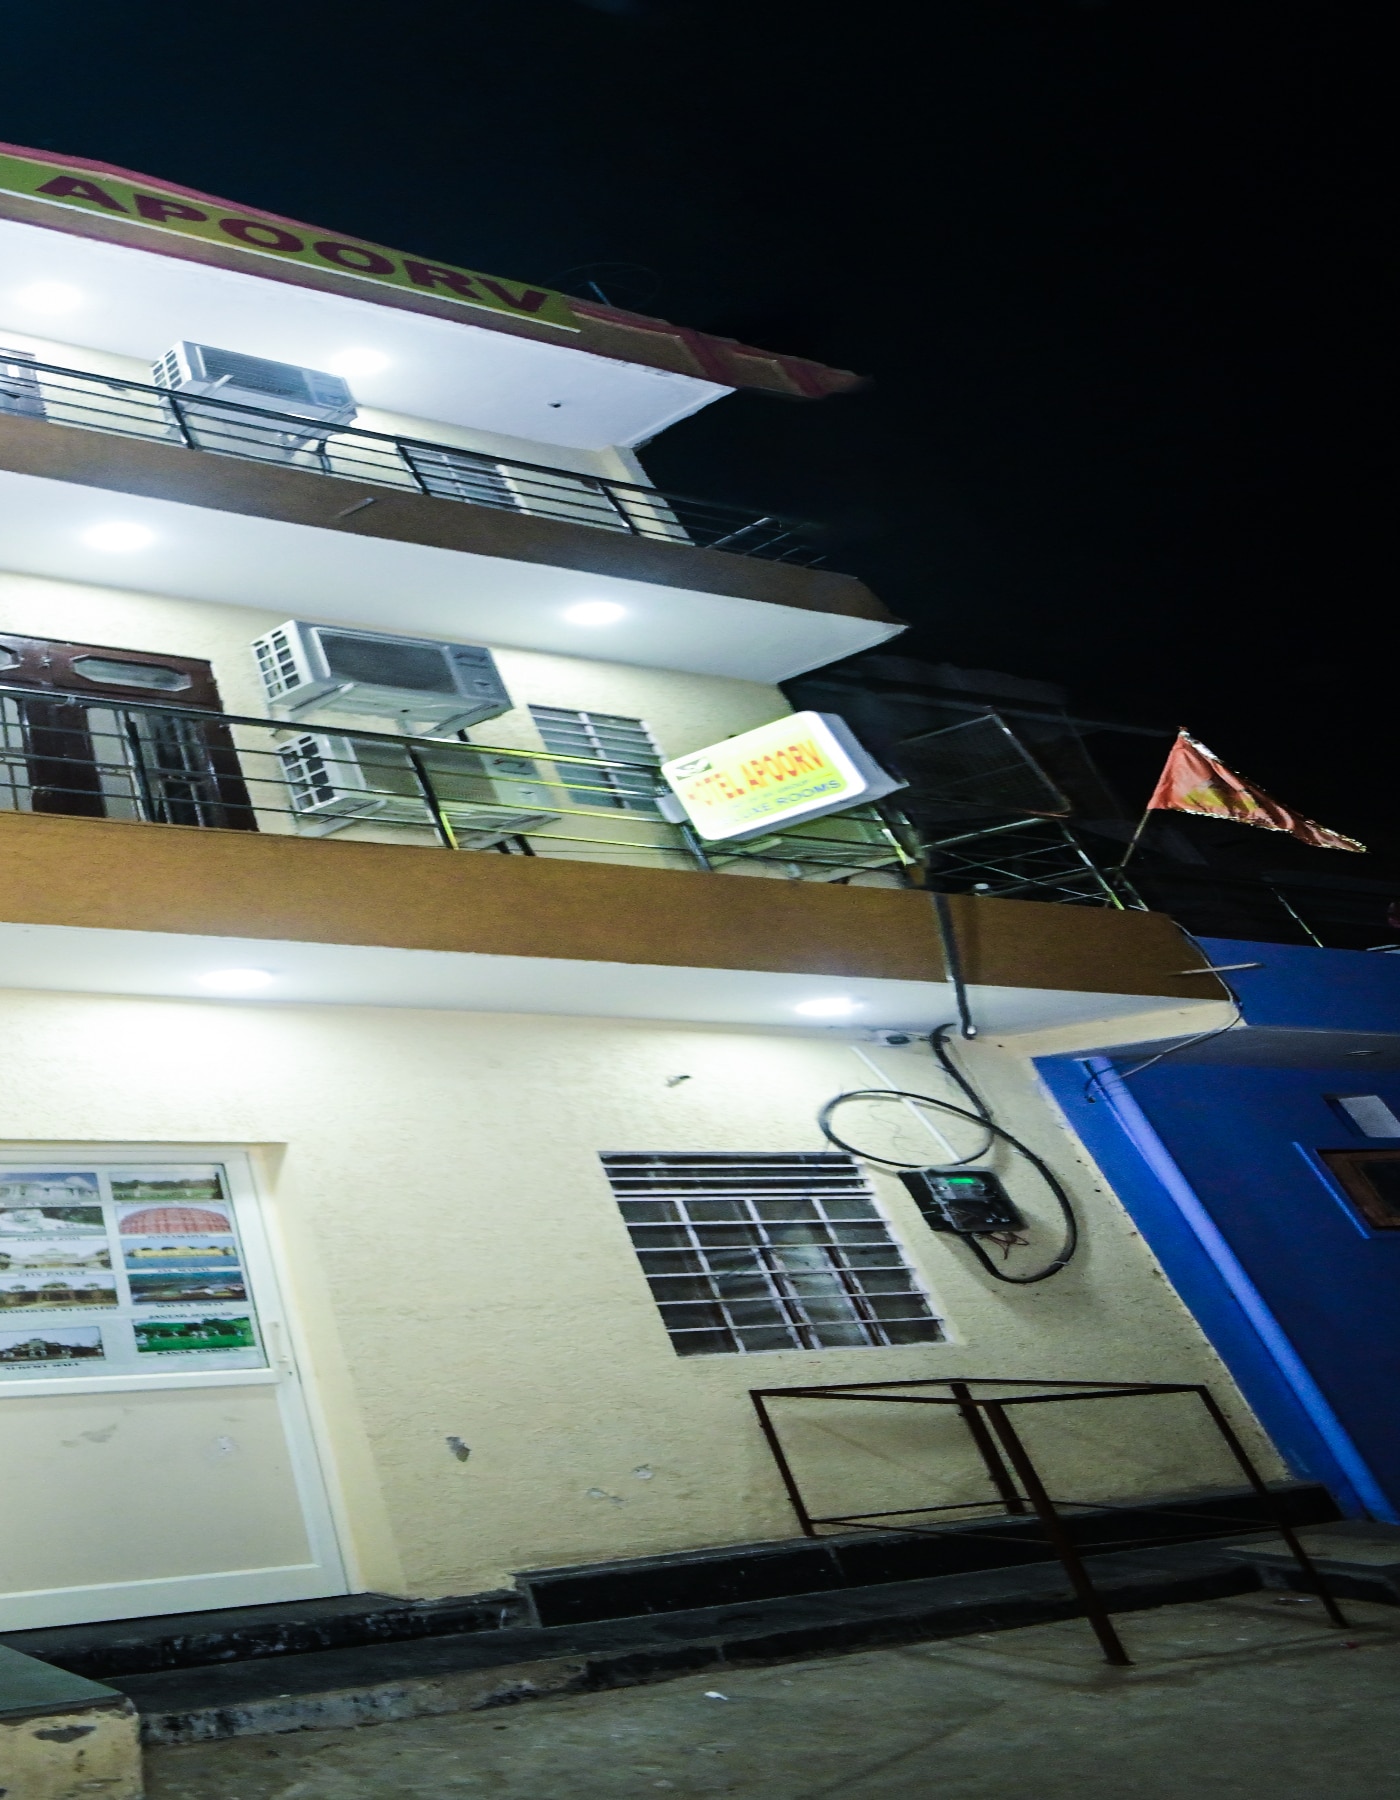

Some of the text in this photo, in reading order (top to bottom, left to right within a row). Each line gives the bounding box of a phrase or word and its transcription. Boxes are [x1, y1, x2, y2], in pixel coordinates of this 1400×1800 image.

[35, 174, 552, 313] APOORV
[740, 740, 824, 789] APOORV
[775, 779, 842, 805] ROOMS
